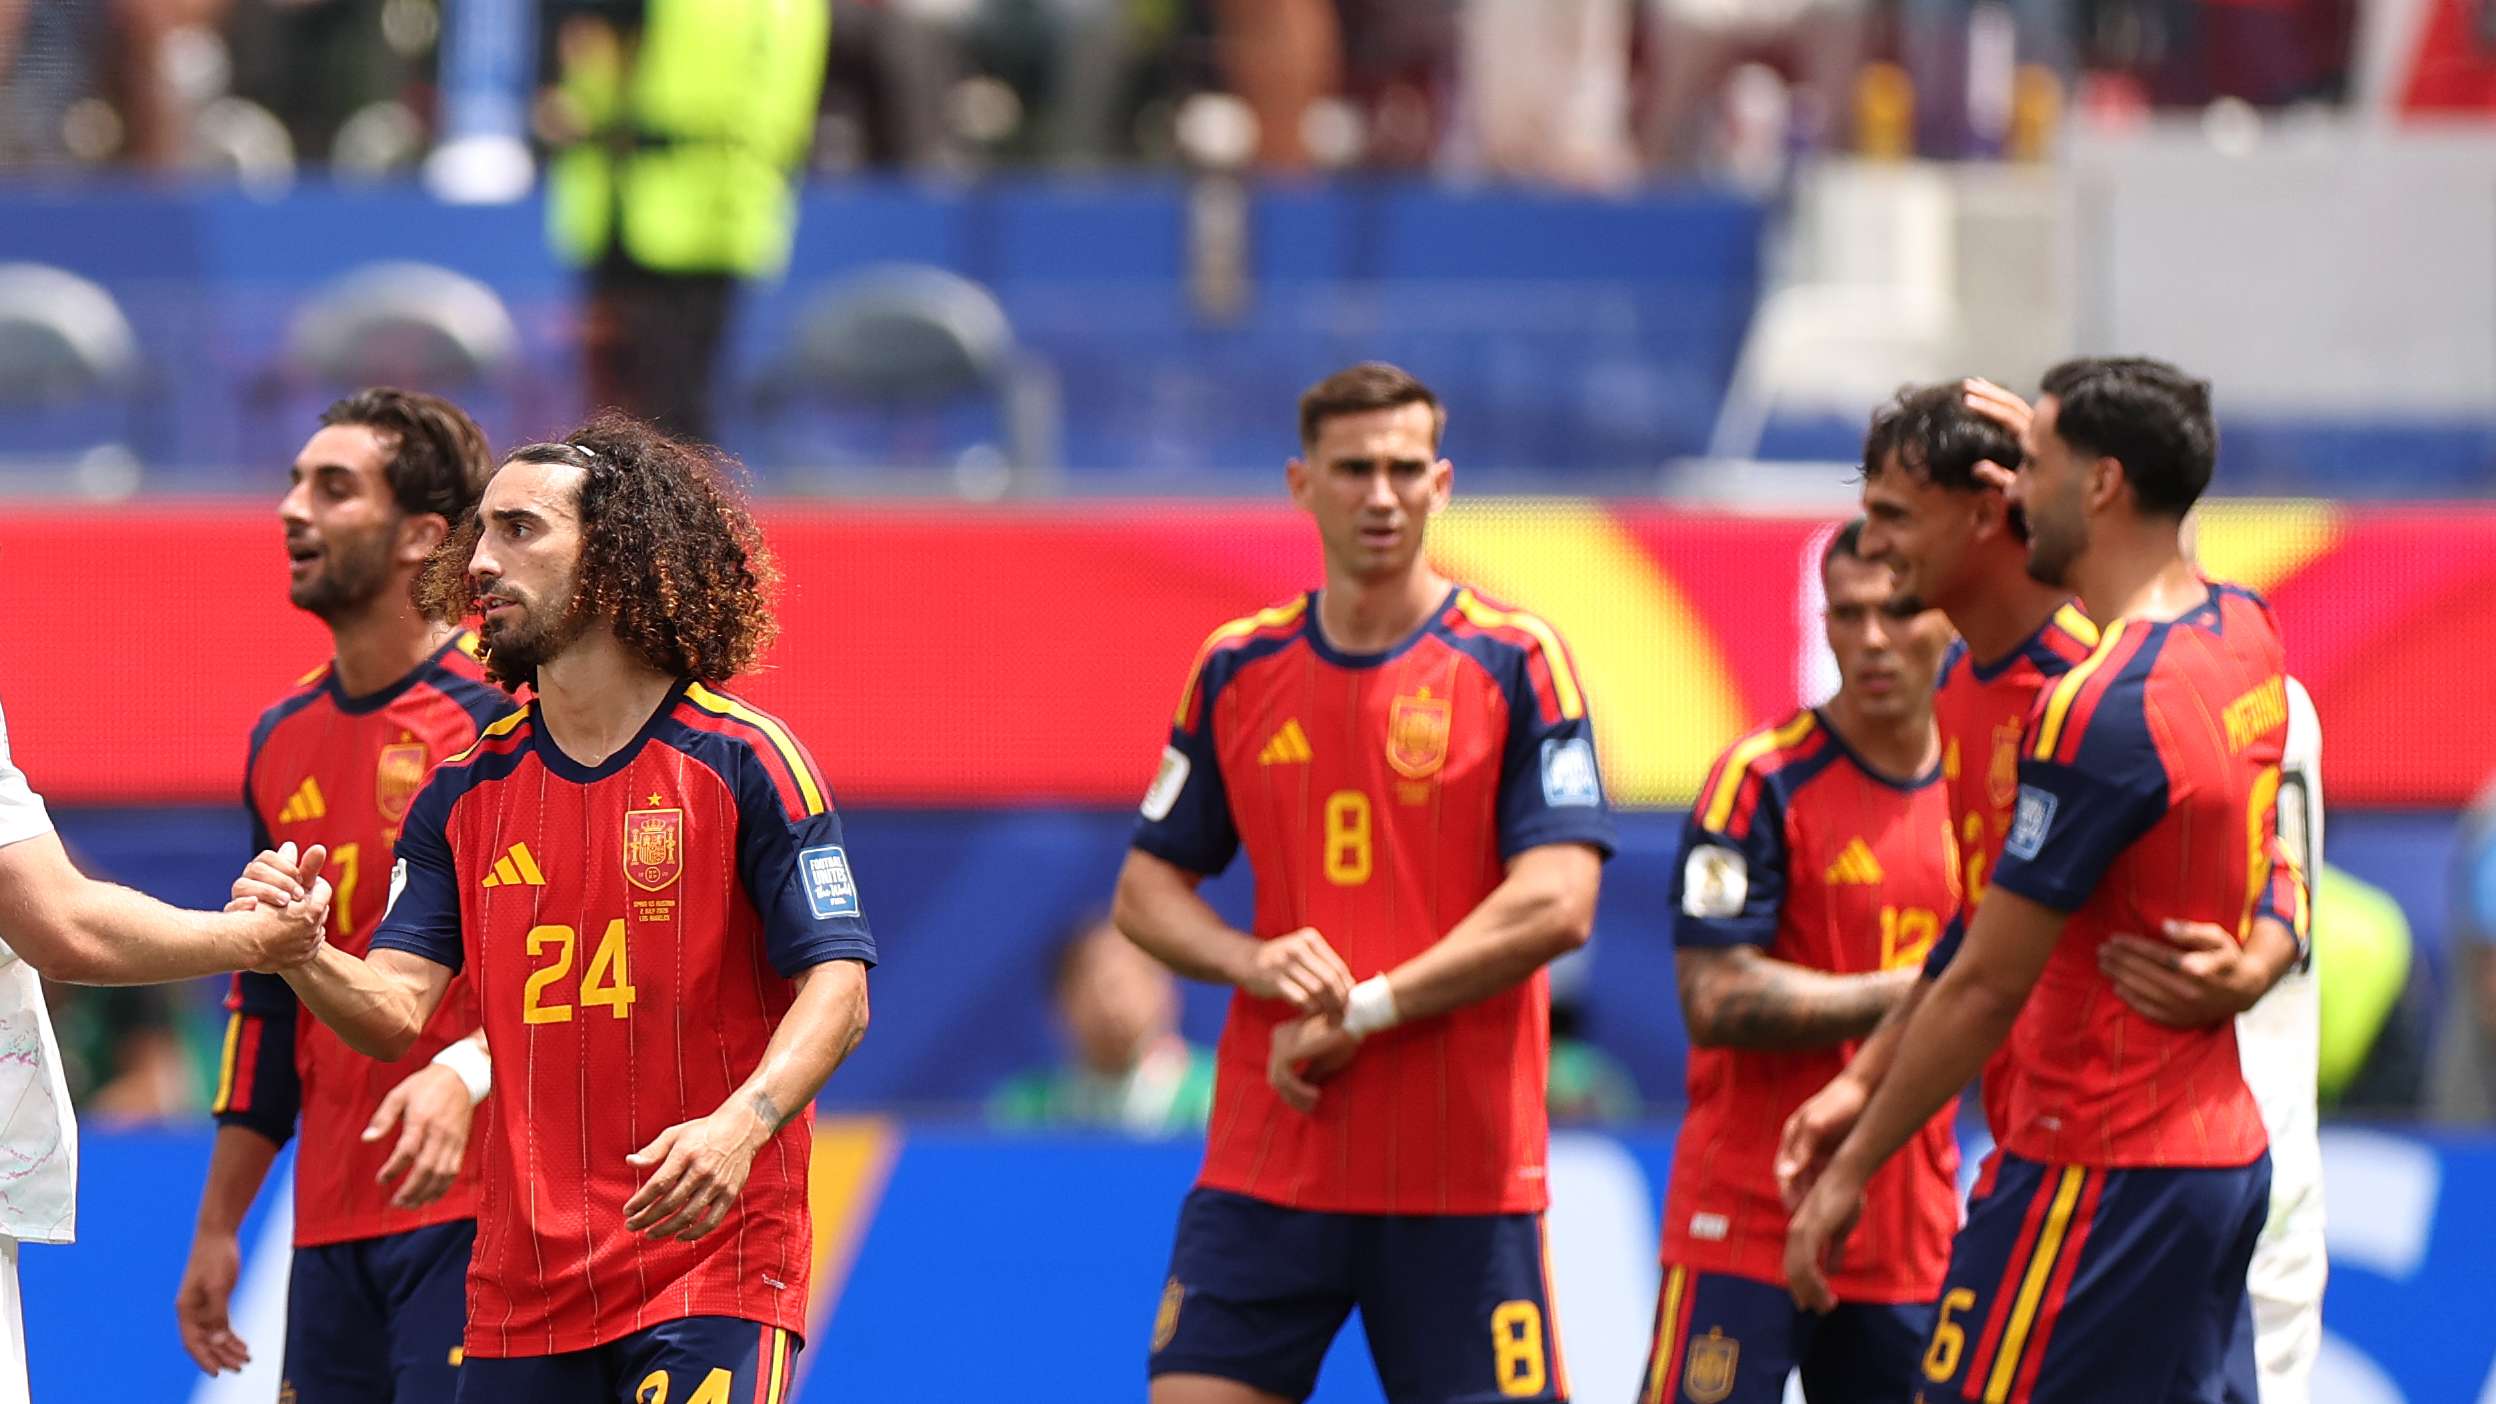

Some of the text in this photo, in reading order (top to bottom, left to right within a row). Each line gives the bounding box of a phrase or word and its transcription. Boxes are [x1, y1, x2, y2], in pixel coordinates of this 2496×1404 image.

[1324, 791, 1371, 886] 8
[332, 842, 360, 936] 7
[523, 918, 636, 1024] 24
[1881, 905, 1940, 972] 12
[1491, 1300, 1546, 1398] 8
[1922, 1287, 1977, 1383] 6
